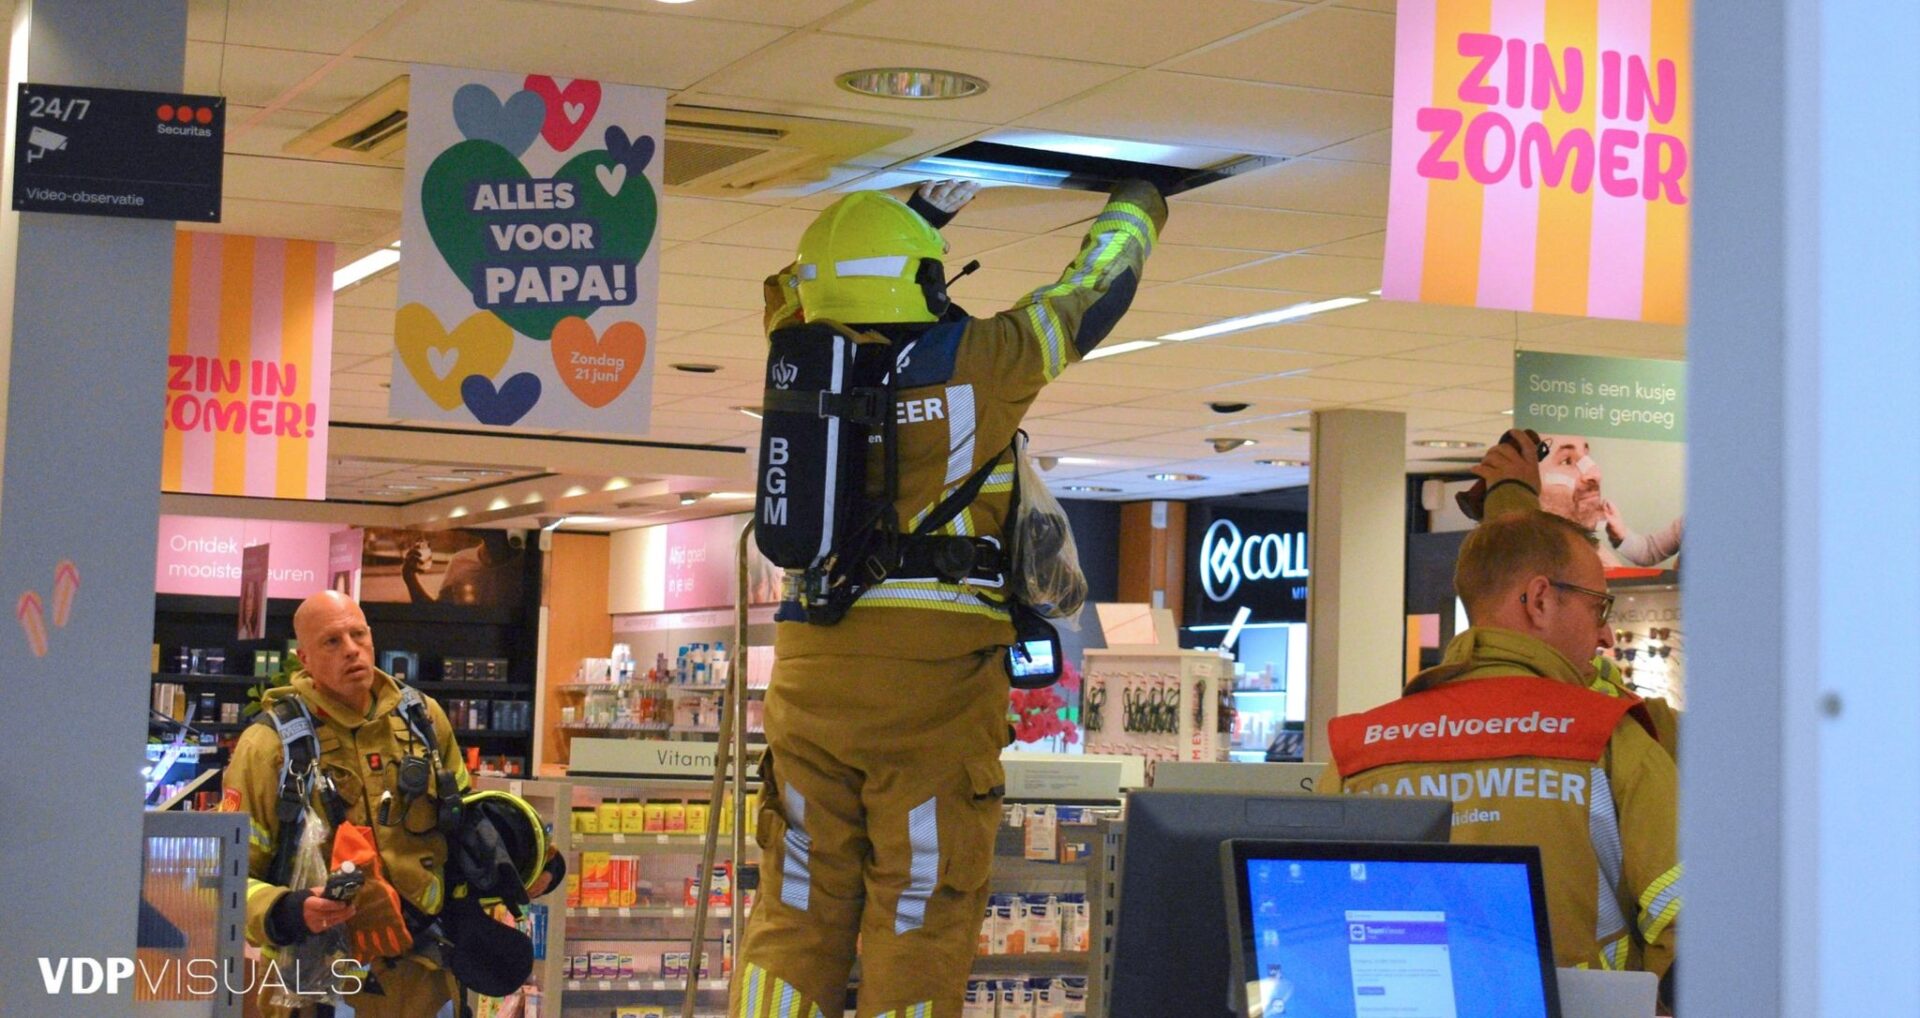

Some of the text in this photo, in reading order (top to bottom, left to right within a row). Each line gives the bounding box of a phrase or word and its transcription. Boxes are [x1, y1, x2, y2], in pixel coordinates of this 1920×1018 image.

[1457, 32, 1676, 125] ZIN IN
[29, 96, 91, 122] 24/7
[157, 123, 212, 138] Securitas
[1416, 107, 1689, 205] ZOMER
[26, 187, 145, 206] Video-observatie
[472, 183, 576, 211] ALLES
[489, 223, 595, 251] VOOR
[485, 264, 628, 304] PAPA!
[570, 351, 625, 372] Zondag
[575, 367, 619, 384] 21 juni
[168, 355, 297, 397] ZIN IN
[1529, 374, 1677, 405] Soms is een kusje
[165, 394, 316, 438] OMER!
[897, 398, 944, 424] EER
[1529, 402, 1675, 430] erop niet genoeg
[170, 534, 238, 555] Ontdek
[169, 561, 242, 579] mooiste
[1364, 711, 1575, 745] Bevelvoerder
